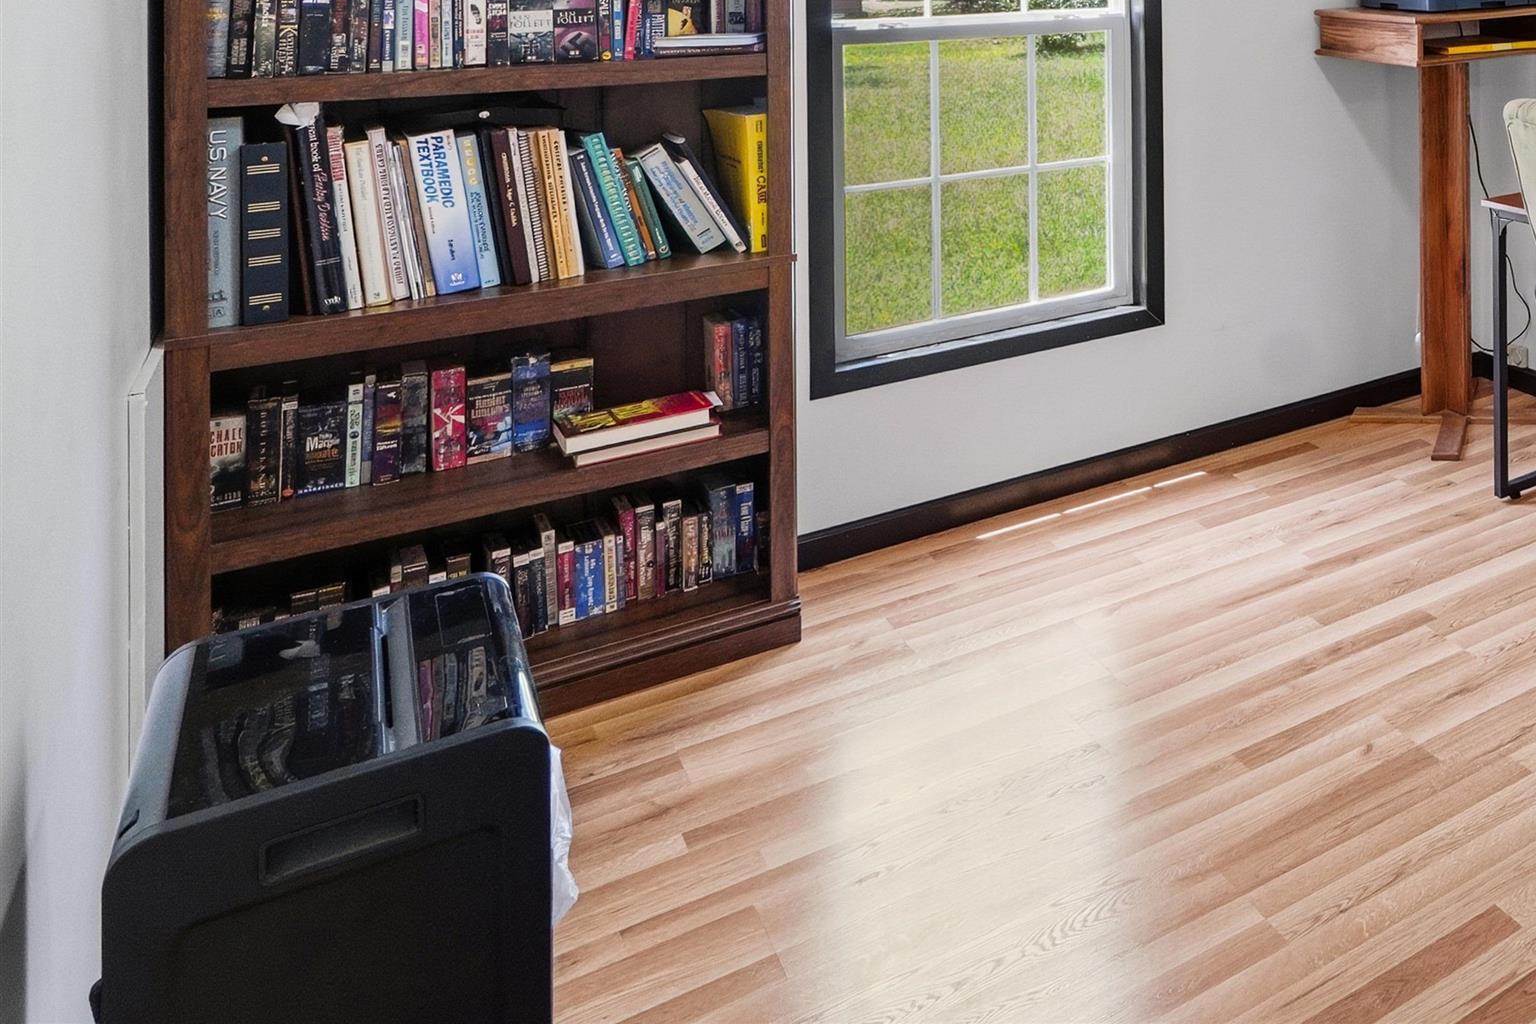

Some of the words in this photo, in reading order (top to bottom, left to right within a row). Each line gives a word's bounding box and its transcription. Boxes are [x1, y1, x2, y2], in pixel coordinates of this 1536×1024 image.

[208, 129, 227, 163] U.S.
[308, 141, 319, 163] book
[415, 137, 439, 204] TEXTBOOK
[430, 135, 455, 209] PARAMEDIC
[208, 166, 227, 220] NAVY
[756, 176, 767, 204] CARE
[210, 427, 243, 444] CHAEL
